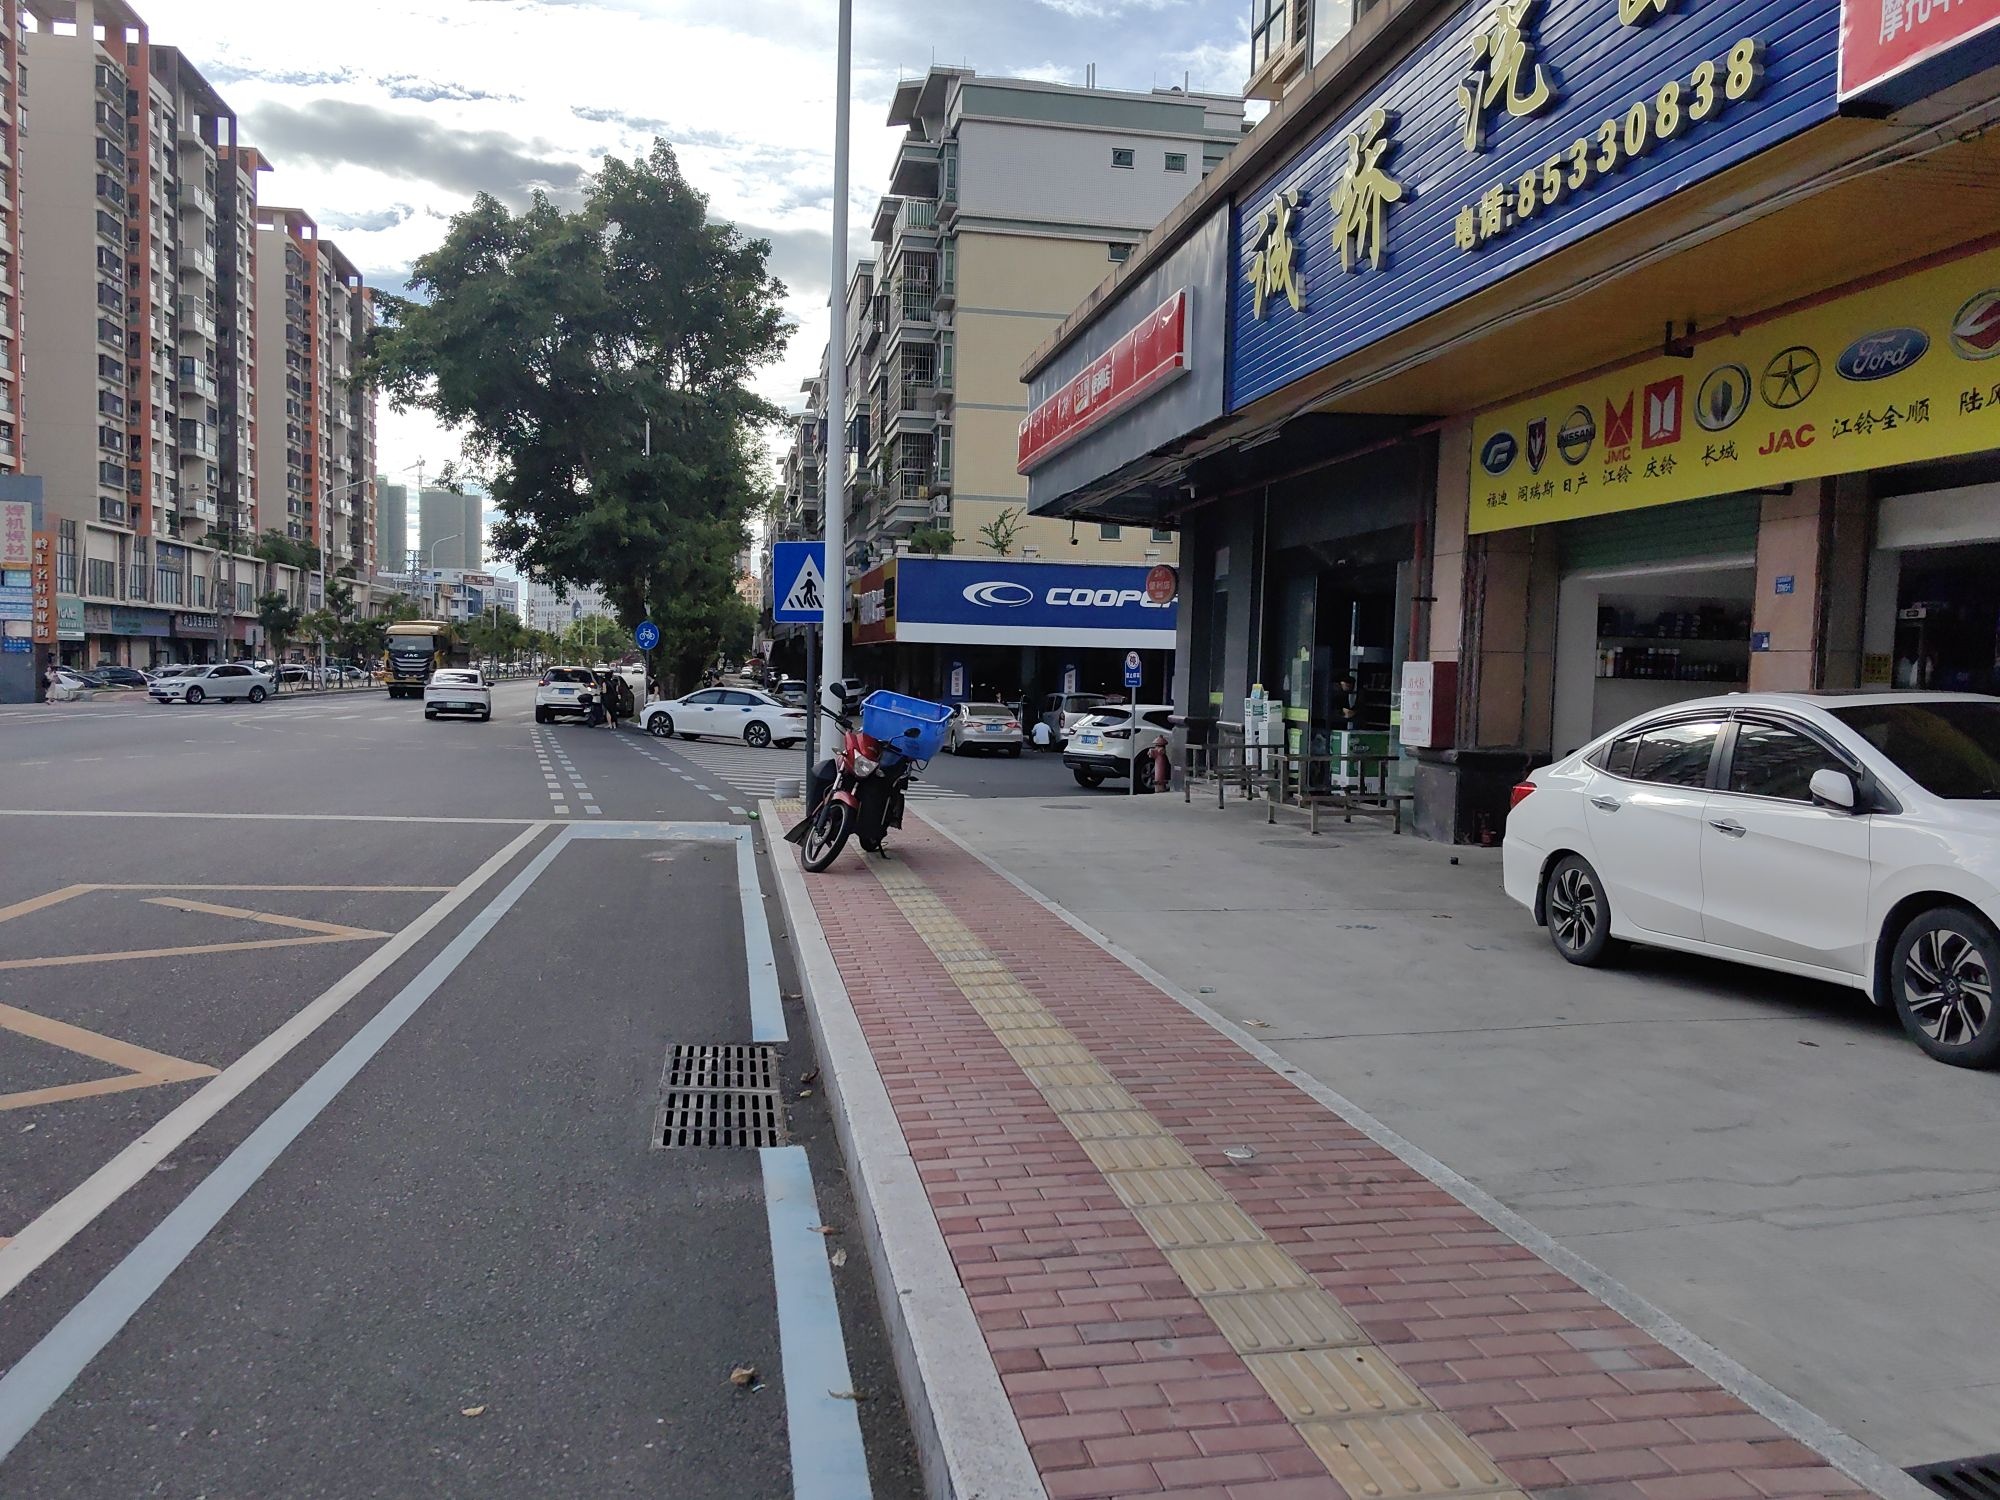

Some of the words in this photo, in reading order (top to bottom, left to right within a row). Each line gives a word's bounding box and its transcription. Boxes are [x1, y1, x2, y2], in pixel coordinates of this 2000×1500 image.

[1852, 335, 1911, 374] Ford
[1560, 426, 1594, 444] NISSAN
[1563, 472, 1588, 495] 日产
[1602, 464, 1632, 486] 江铃
[1643, 453, 1677, 478] 庆铃
[1701, 440, 1738, 467] 长城
[1759, 424, 1816, 455] JAC
[1832, 398, 1930, 439] 江铃全顺
[1604, 447, 1632, 465] JMC
[1045, 587, 1178, 608] COOPE
